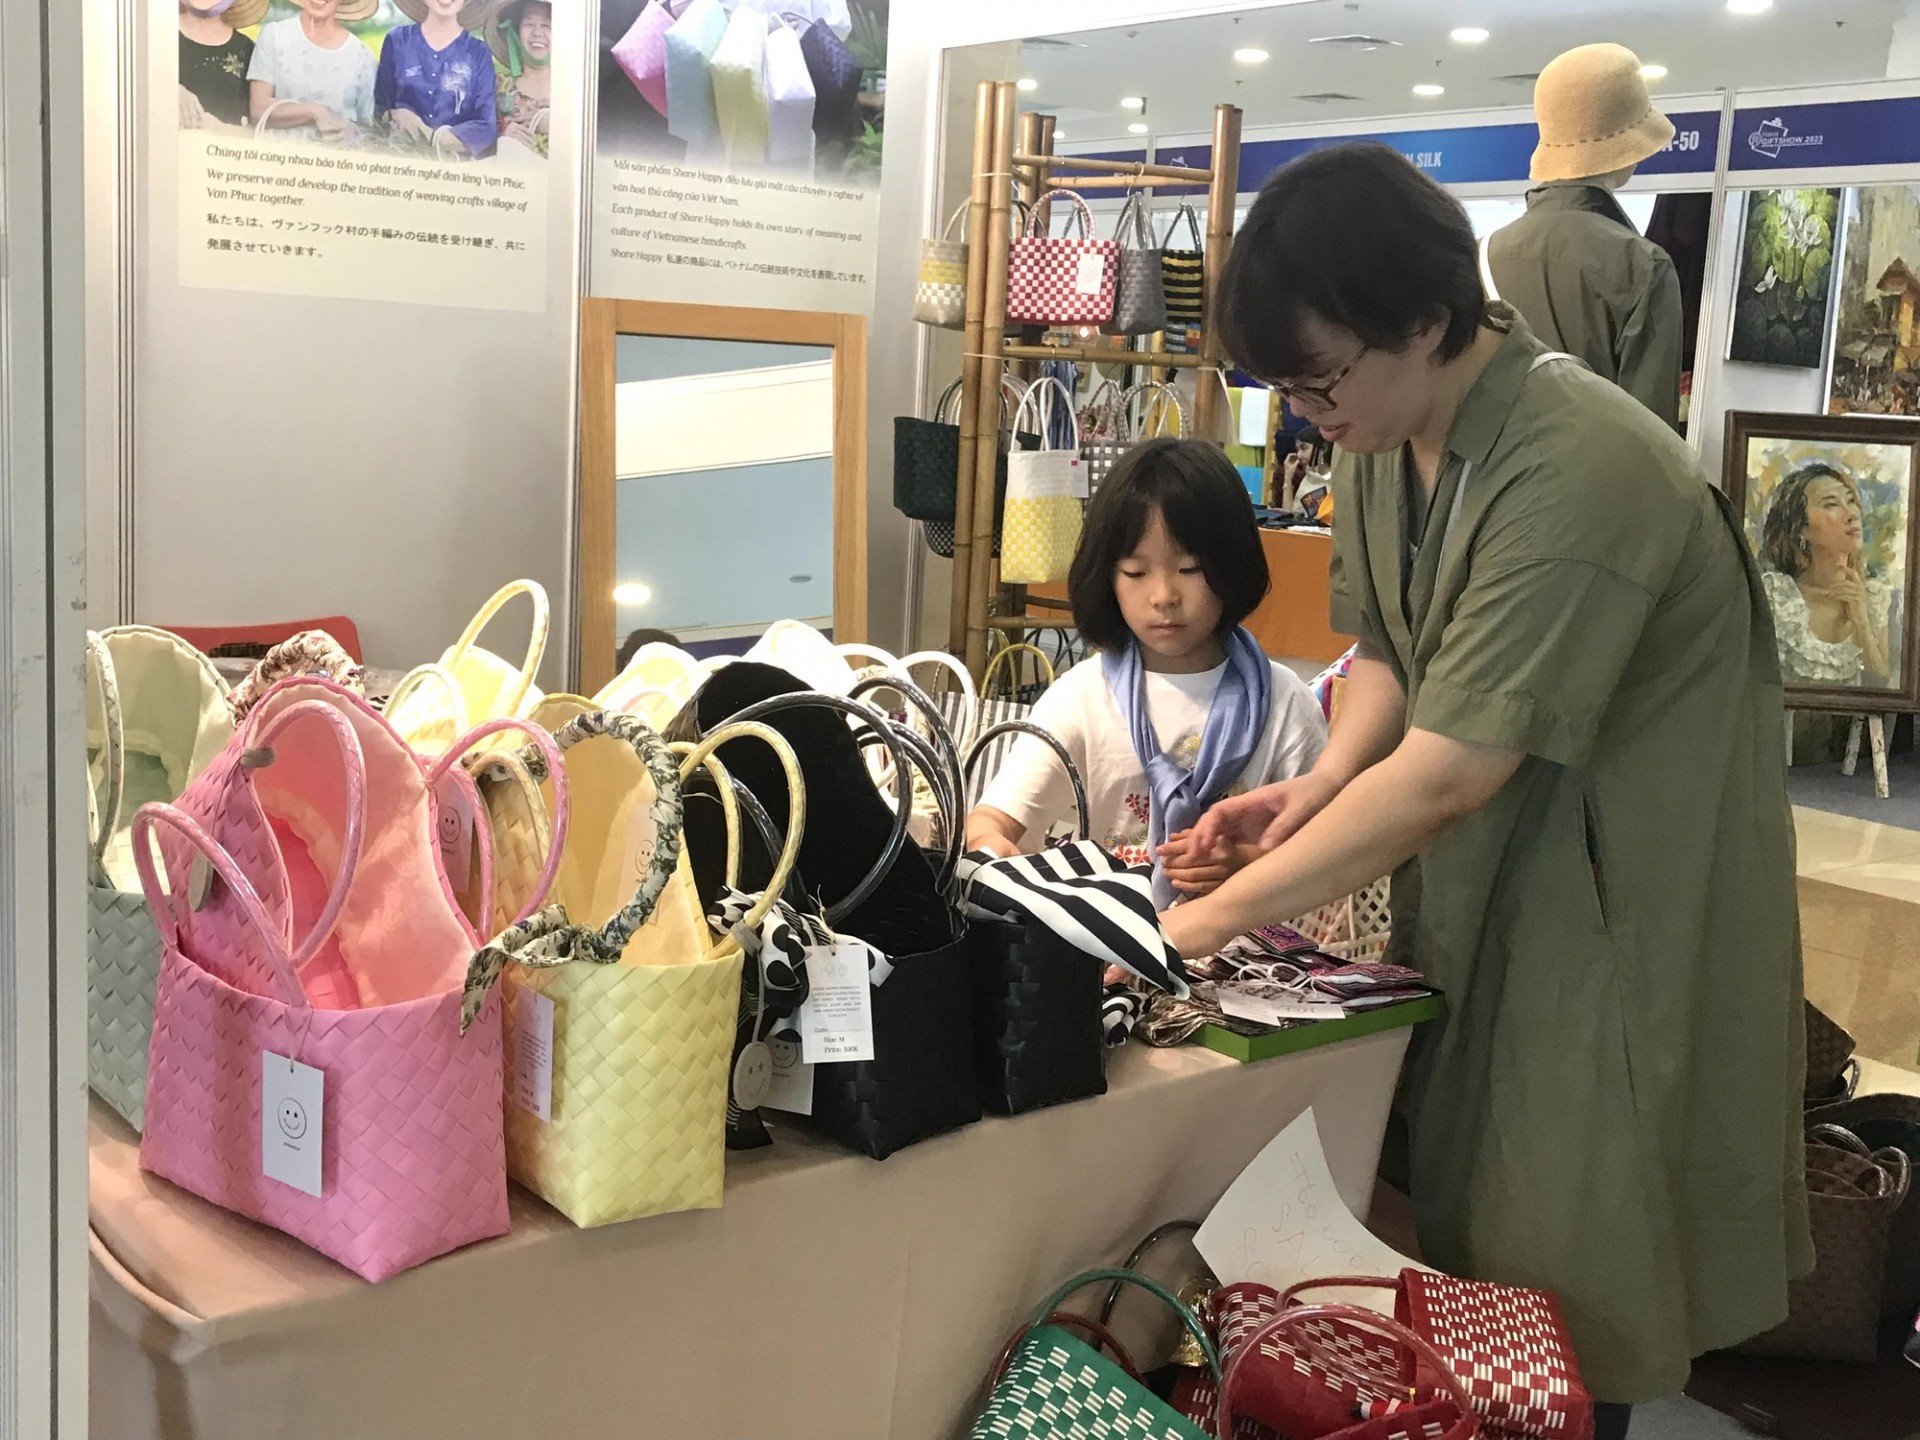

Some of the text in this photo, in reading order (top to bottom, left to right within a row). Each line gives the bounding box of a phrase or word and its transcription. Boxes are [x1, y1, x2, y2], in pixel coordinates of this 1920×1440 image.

[1762, 135, 1823, 145] GIFTSHOW 2023
[206, 144, 241, 161] Chúng
[244, 149, 258, 160] tôi
[260, 151, 285, 165] cùng
[288, 155, 313, 166] nhau
[356, 162, 367, 172] và
[369, 163, 391, 175] phát
[443, 171, 460, 182] đan
[462, 173, 481, 187] làng
[1416, 152, 1441, 168] SILK
[672, 167, 696, 179] Share
[697, 171, 723, 184] Happy
[207, 168, 528, 213] We preserve and develop the tradition of weaving crafts village of
[207, 187, 305, 206] Van Phuc together.
[612, 203, 862, 242] Each product of Share Happy holds its own story of meaning and
[611, 226, 747, 250] culture of Vietnamese handicrafts.
[610, 247, 634, 259] Share
[636, 251, 663, 264] Happy
